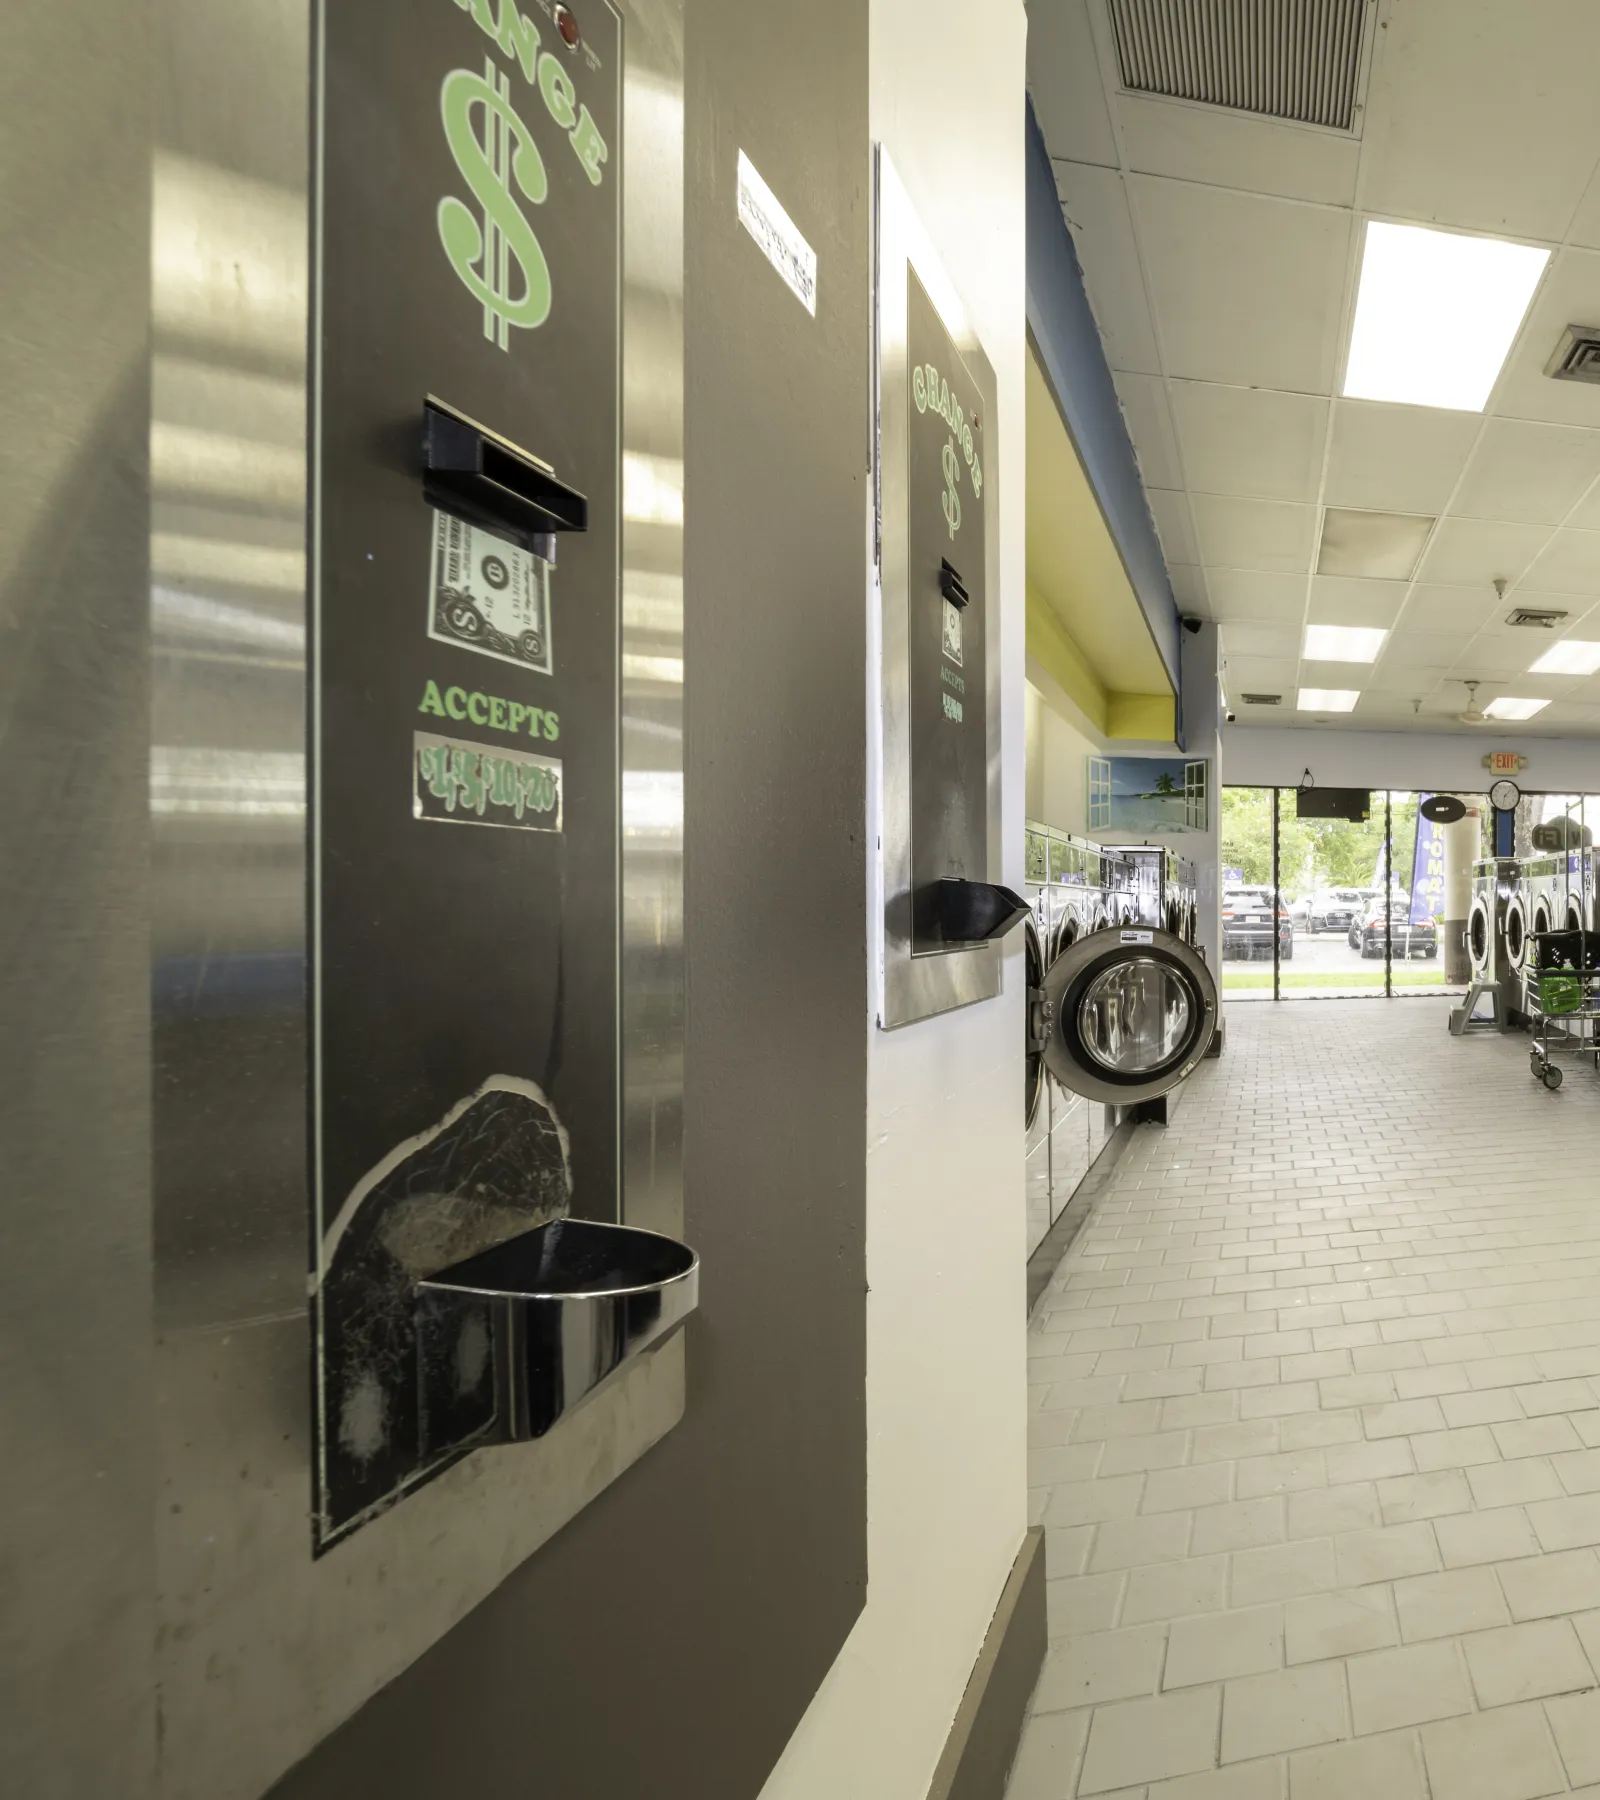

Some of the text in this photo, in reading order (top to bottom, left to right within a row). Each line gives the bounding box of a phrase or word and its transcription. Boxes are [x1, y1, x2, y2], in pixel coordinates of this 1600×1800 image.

[913, 363, 982, 498] CHANGE
[417, 679, 560, 742] ACCEPTS
[1496, 753, 1514, 769] EXIT
